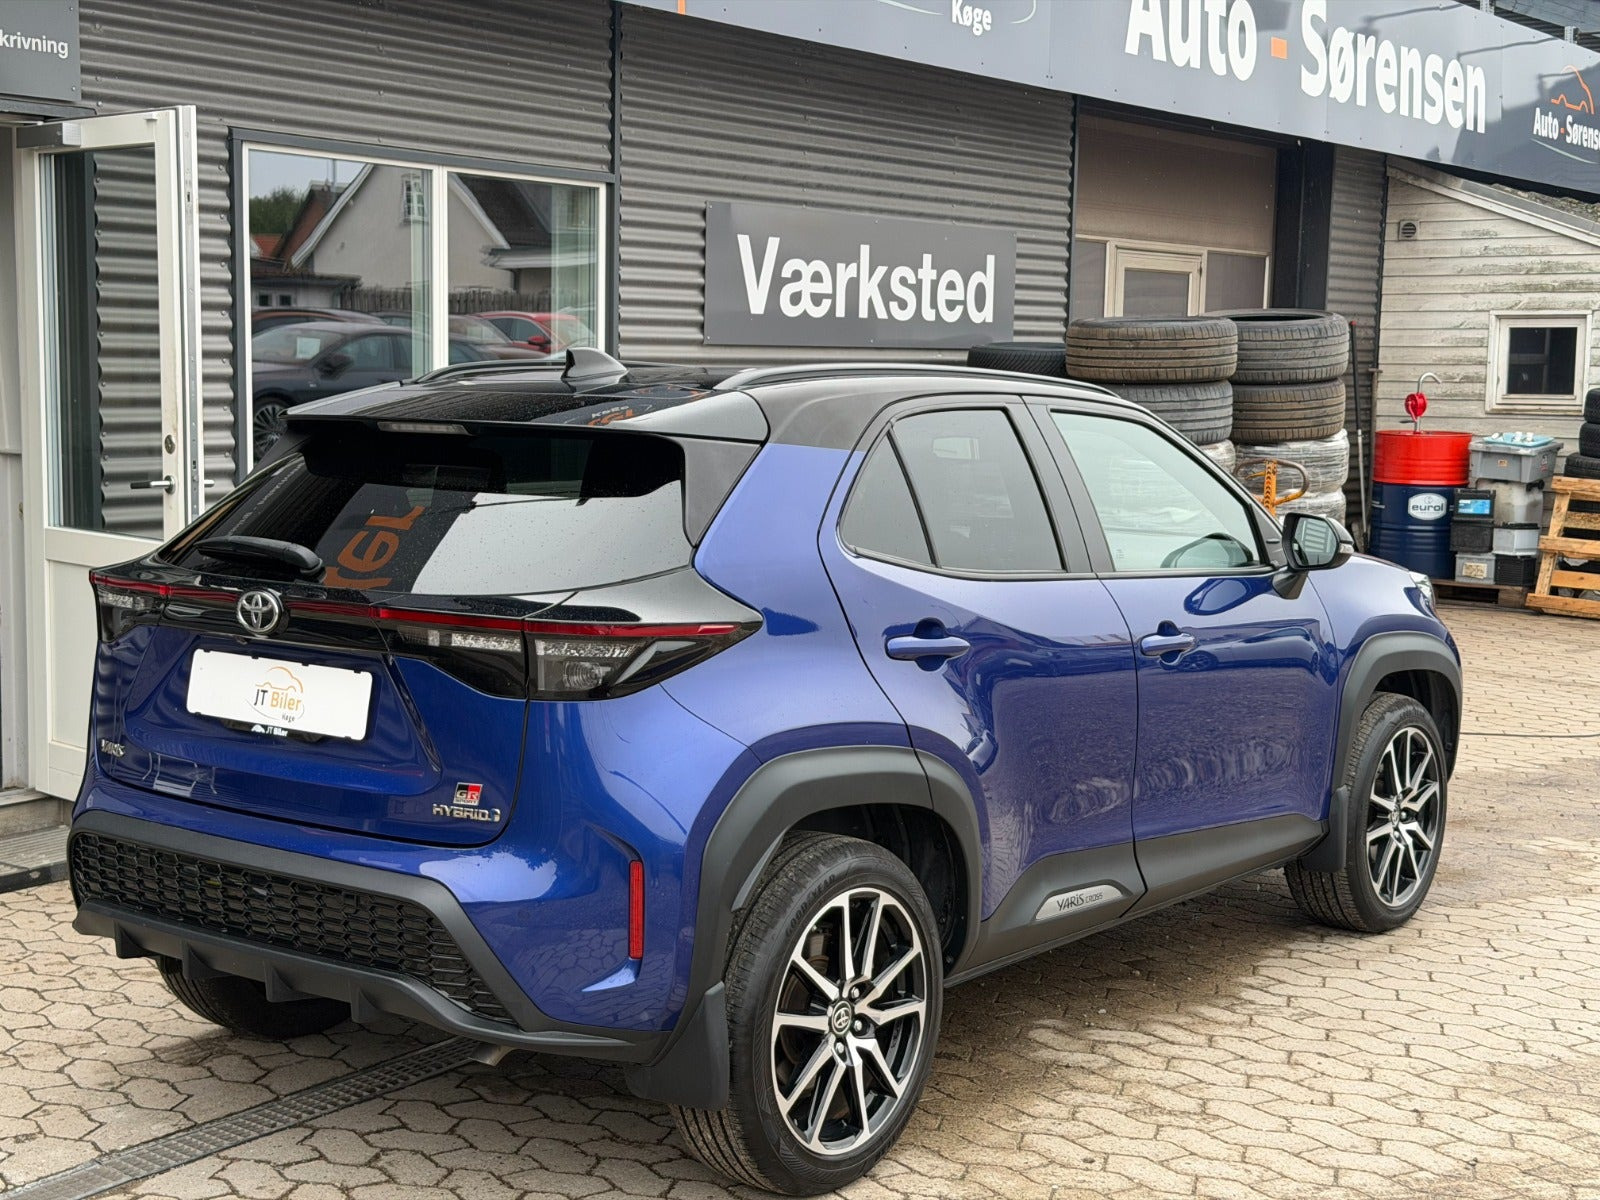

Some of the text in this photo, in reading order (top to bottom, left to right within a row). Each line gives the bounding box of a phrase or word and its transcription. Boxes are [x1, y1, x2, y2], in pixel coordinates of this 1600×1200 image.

[951, 0, 992, 36] Køge
[1300, 0, 1486, 134] Sørensen
[1532, 107, 1559, 140] Auto
[736, 233, 996, 324] Værksted
[1411, 503, 1444, 511] eurol
[270, 690, 302, 711] Biler
[456, 790, 480, 800] GR
[432, 803, 489, 821] HYBRID
